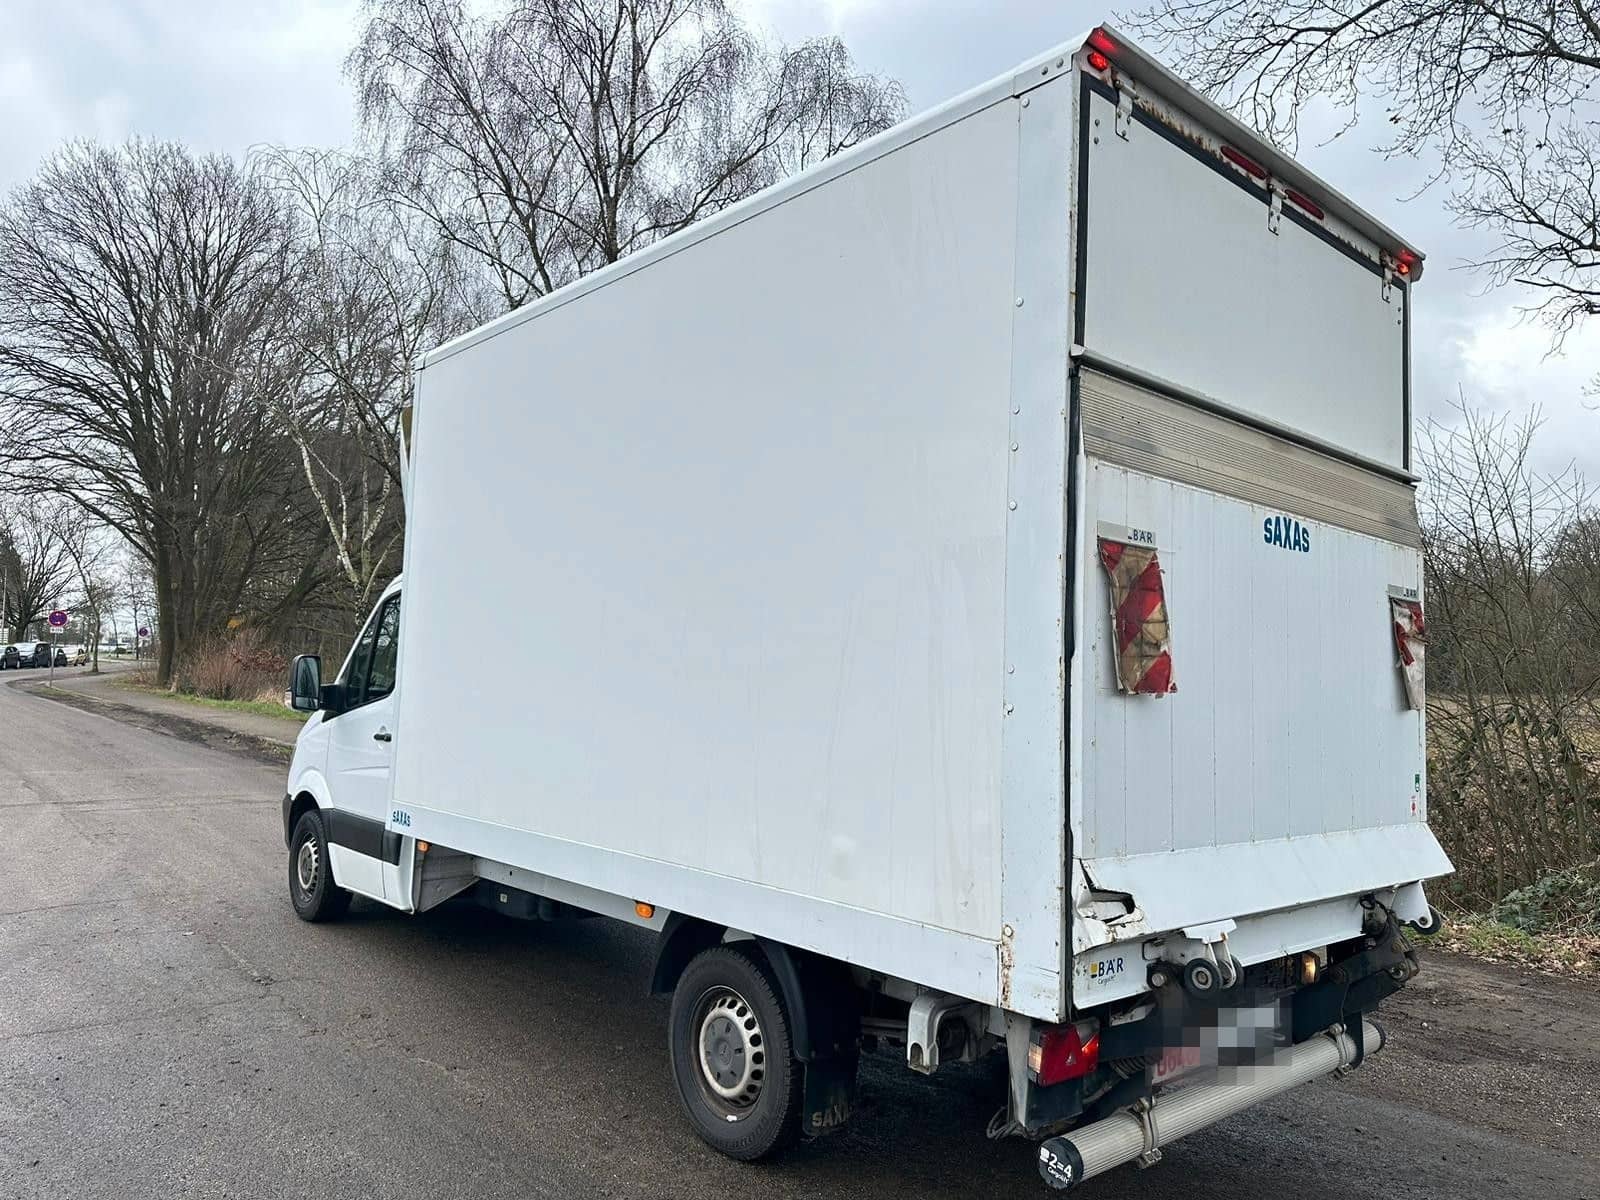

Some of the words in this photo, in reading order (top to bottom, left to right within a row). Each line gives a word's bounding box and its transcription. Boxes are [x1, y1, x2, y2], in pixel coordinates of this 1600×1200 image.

[1264, 516, 1310, 553] SAXAS
[392, 810, 410, 827] SAXAS
[1098, 957, 1124, 977] BÄR
[1049, 1152, 1072, 1179] 2=4
